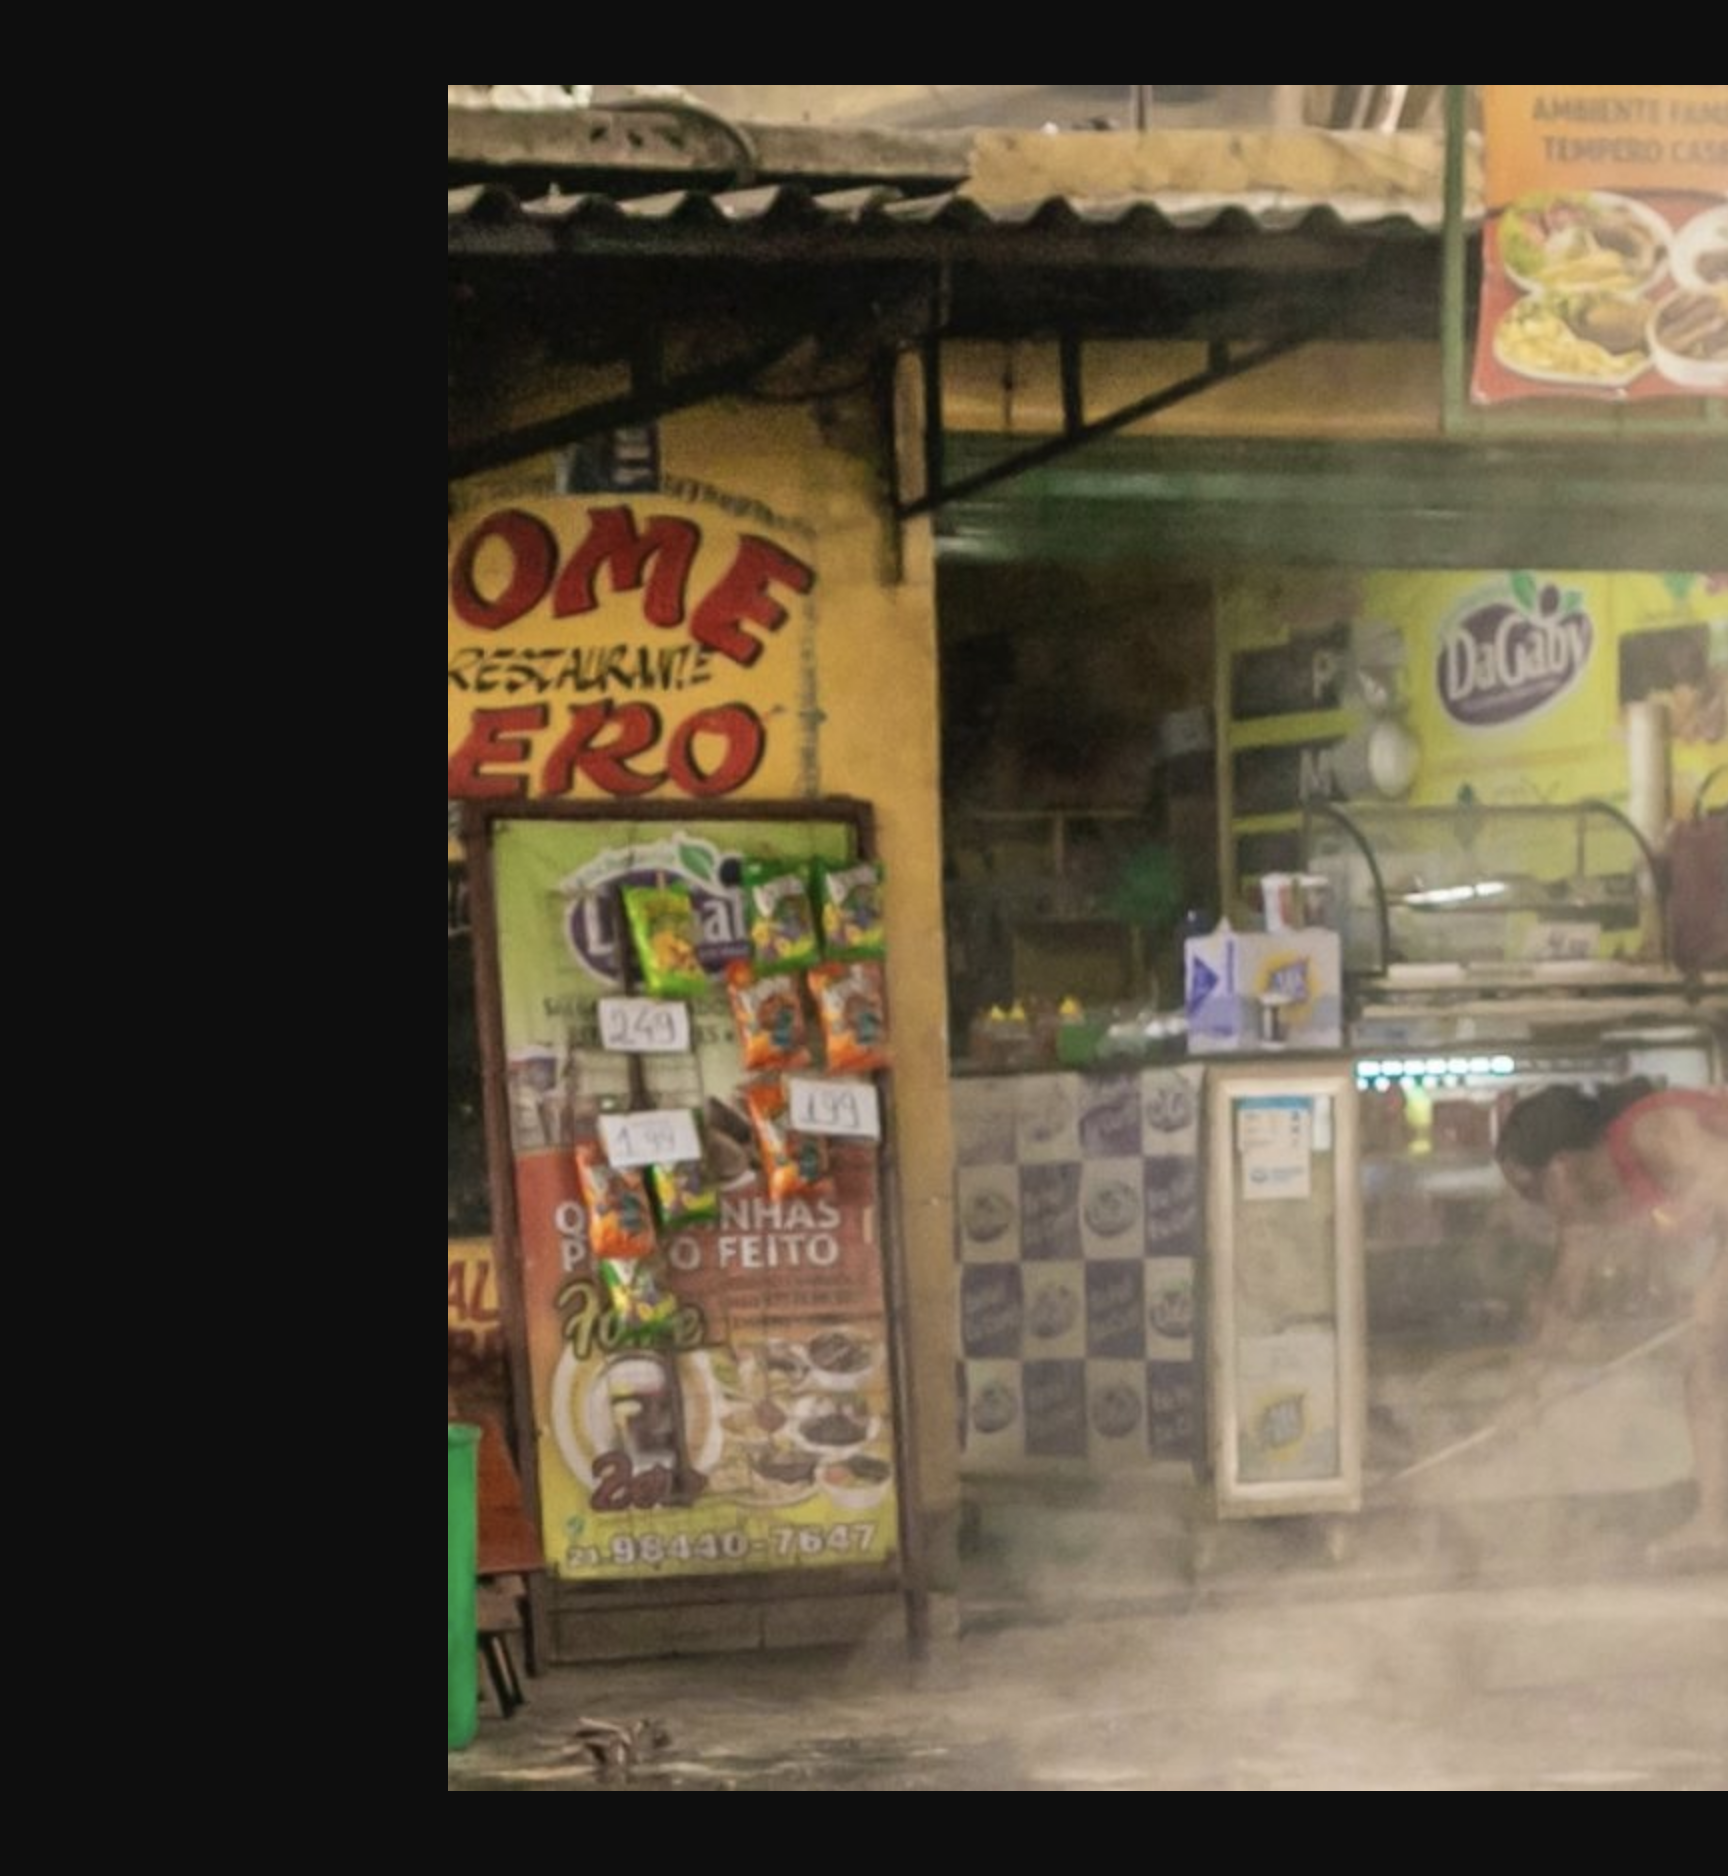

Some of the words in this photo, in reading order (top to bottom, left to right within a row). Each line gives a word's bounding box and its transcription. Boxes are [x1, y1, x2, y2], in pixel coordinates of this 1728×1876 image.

[1532, 97, 1661, 124] AMBIENTE
[1543, 136, 1664, 163] TEMPERO
[447, 504, 817, 669] OME
[447, 642, 720, 694] RESTAURANTE
[1446, 610, 1589, 701] DaGaby
[447, 697, 768, 798] ERO
[555, 1197, 841, 1234] QNHAS
[718, 1233, 840, 1270] FEITO
